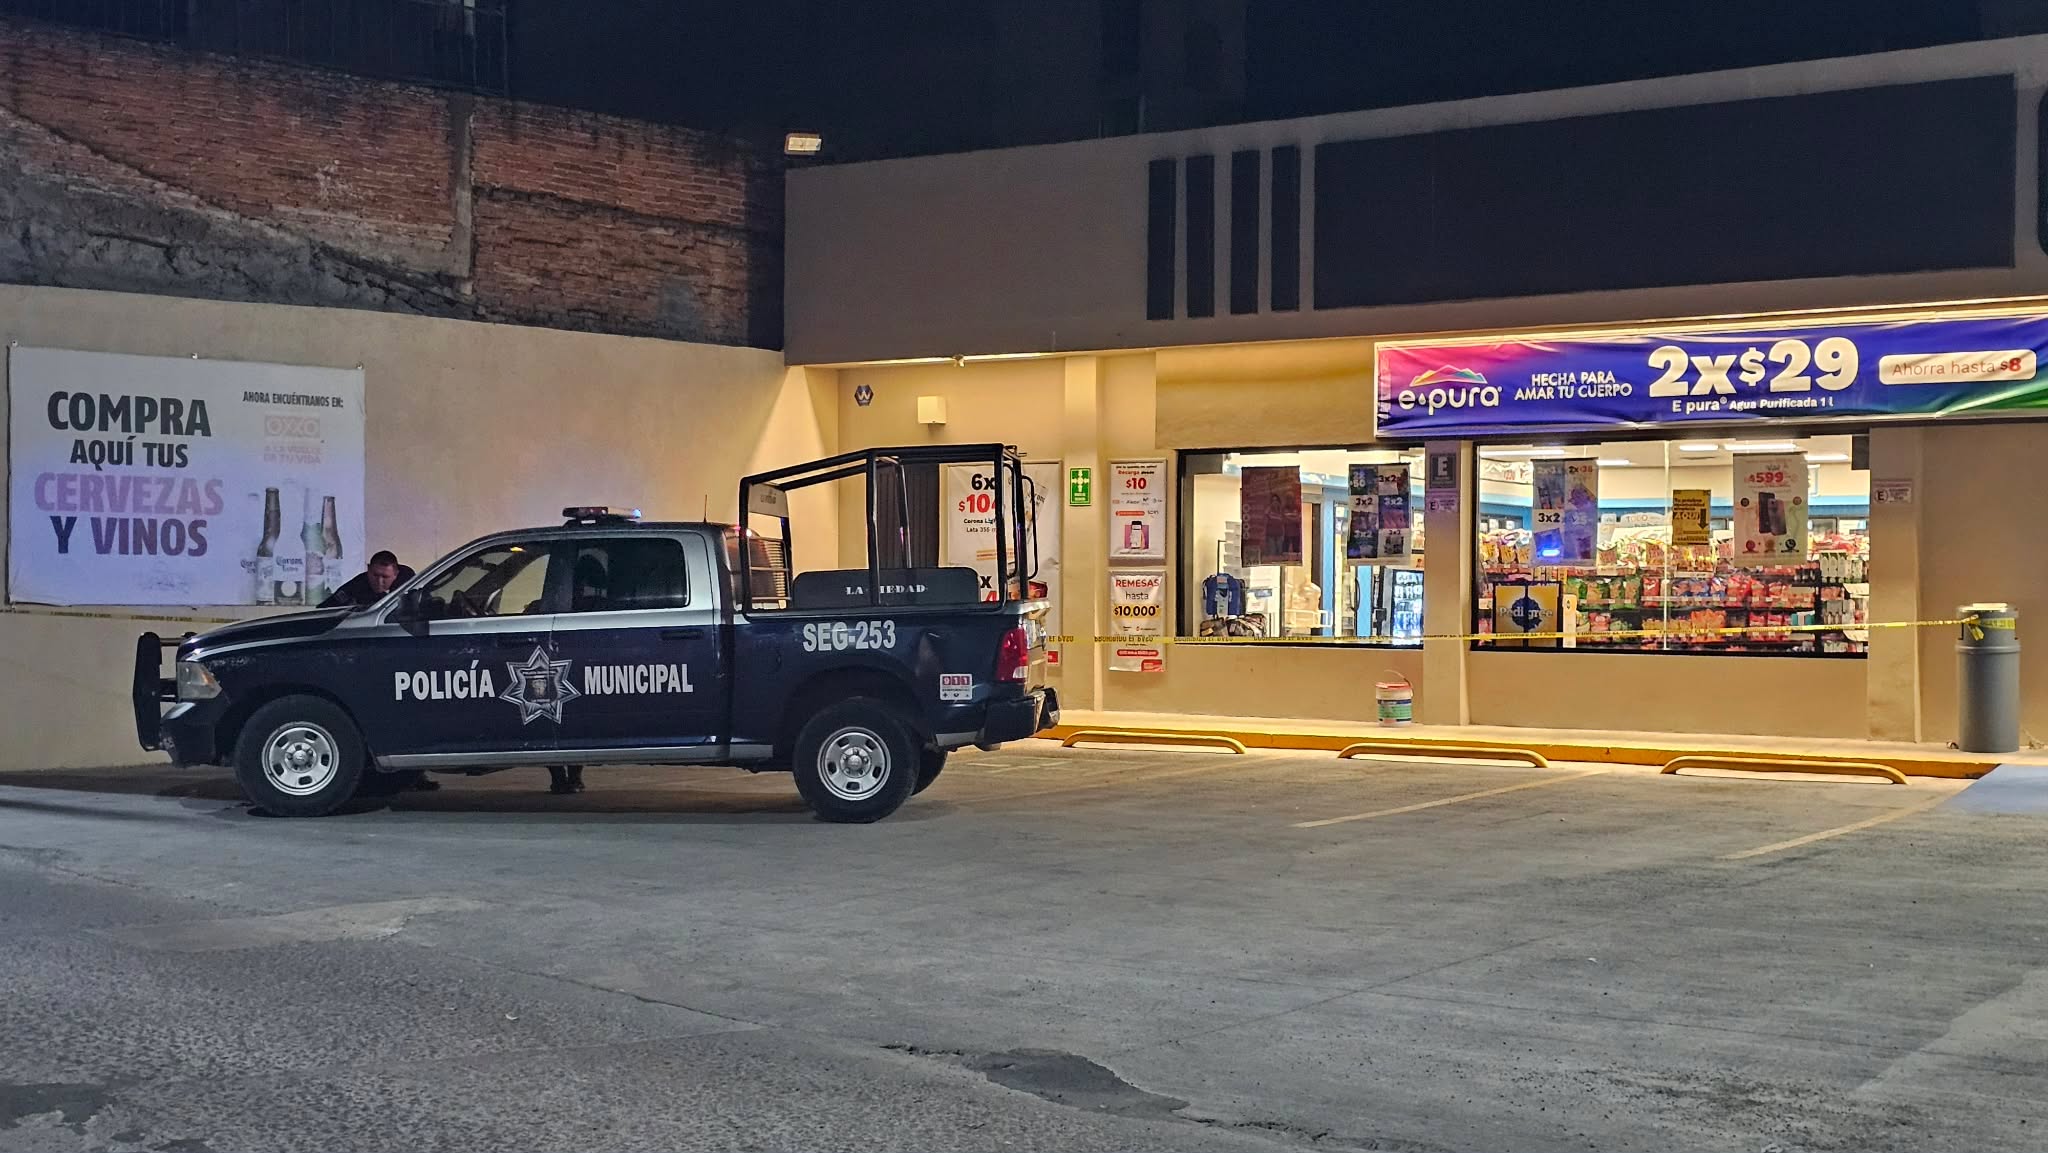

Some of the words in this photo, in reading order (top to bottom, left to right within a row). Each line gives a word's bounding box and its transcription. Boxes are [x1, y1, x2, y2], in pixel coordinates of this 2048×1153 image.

[1647, 336, 1859, 397] 2x$29
[1892, 362, 1945, 376] Ahorra
[1951, 360, 1995, 375] hasta
[2000, 357, 2022, 372] $8
[1531, 373, 1577, 386] HECHA
[1580, 370, 1615, 384] PARA
[242, 391, 270, 403] AHORA
[272, 392, 330, 407] ENCUÉNTRANOS
[1514, 387, 1554, 400] AMAR
[1558, 385, 1575, 398] TU
[1578, 382, 1633, 398] CUERPO
[1672, 400, 1682, 412] E
[1729, 399, 1757, 411] Agua
[1760, 397, 1817, 408] Purificada
[47, 391, 212, 437] COMPRA
[70, 436, 134, 470] AQUÍ
[142, 442, 189, 468] TUS
[1438, 456, 1448, 476] E
[971, 474, 995, 490] 6x
[1125, 478, 1147, 490] $10
[34, 472, 225, 516] CERVEZAS
[1355, 497, 1374, 506] 3x2
[1878, 490, 1885, 500] E
[1538, 513, 1561, 523] 3x2
[49, 516, 78, 554] Y
[90, 516, 208, 557] VINOS
[846, 586, 864, 595] LA
[880, 584, 927, 594] IEDAD
[1115, 579, 1160, 587] REMESAS
[1125, 591, 1150, 600] hasta
[802, 620, 896, 652] SEG-253
[394, 660, 496, 700] POLICÍA
[583, 663, 694, 696] MUNICIPAL
[943, 676, 969, 685] 911
